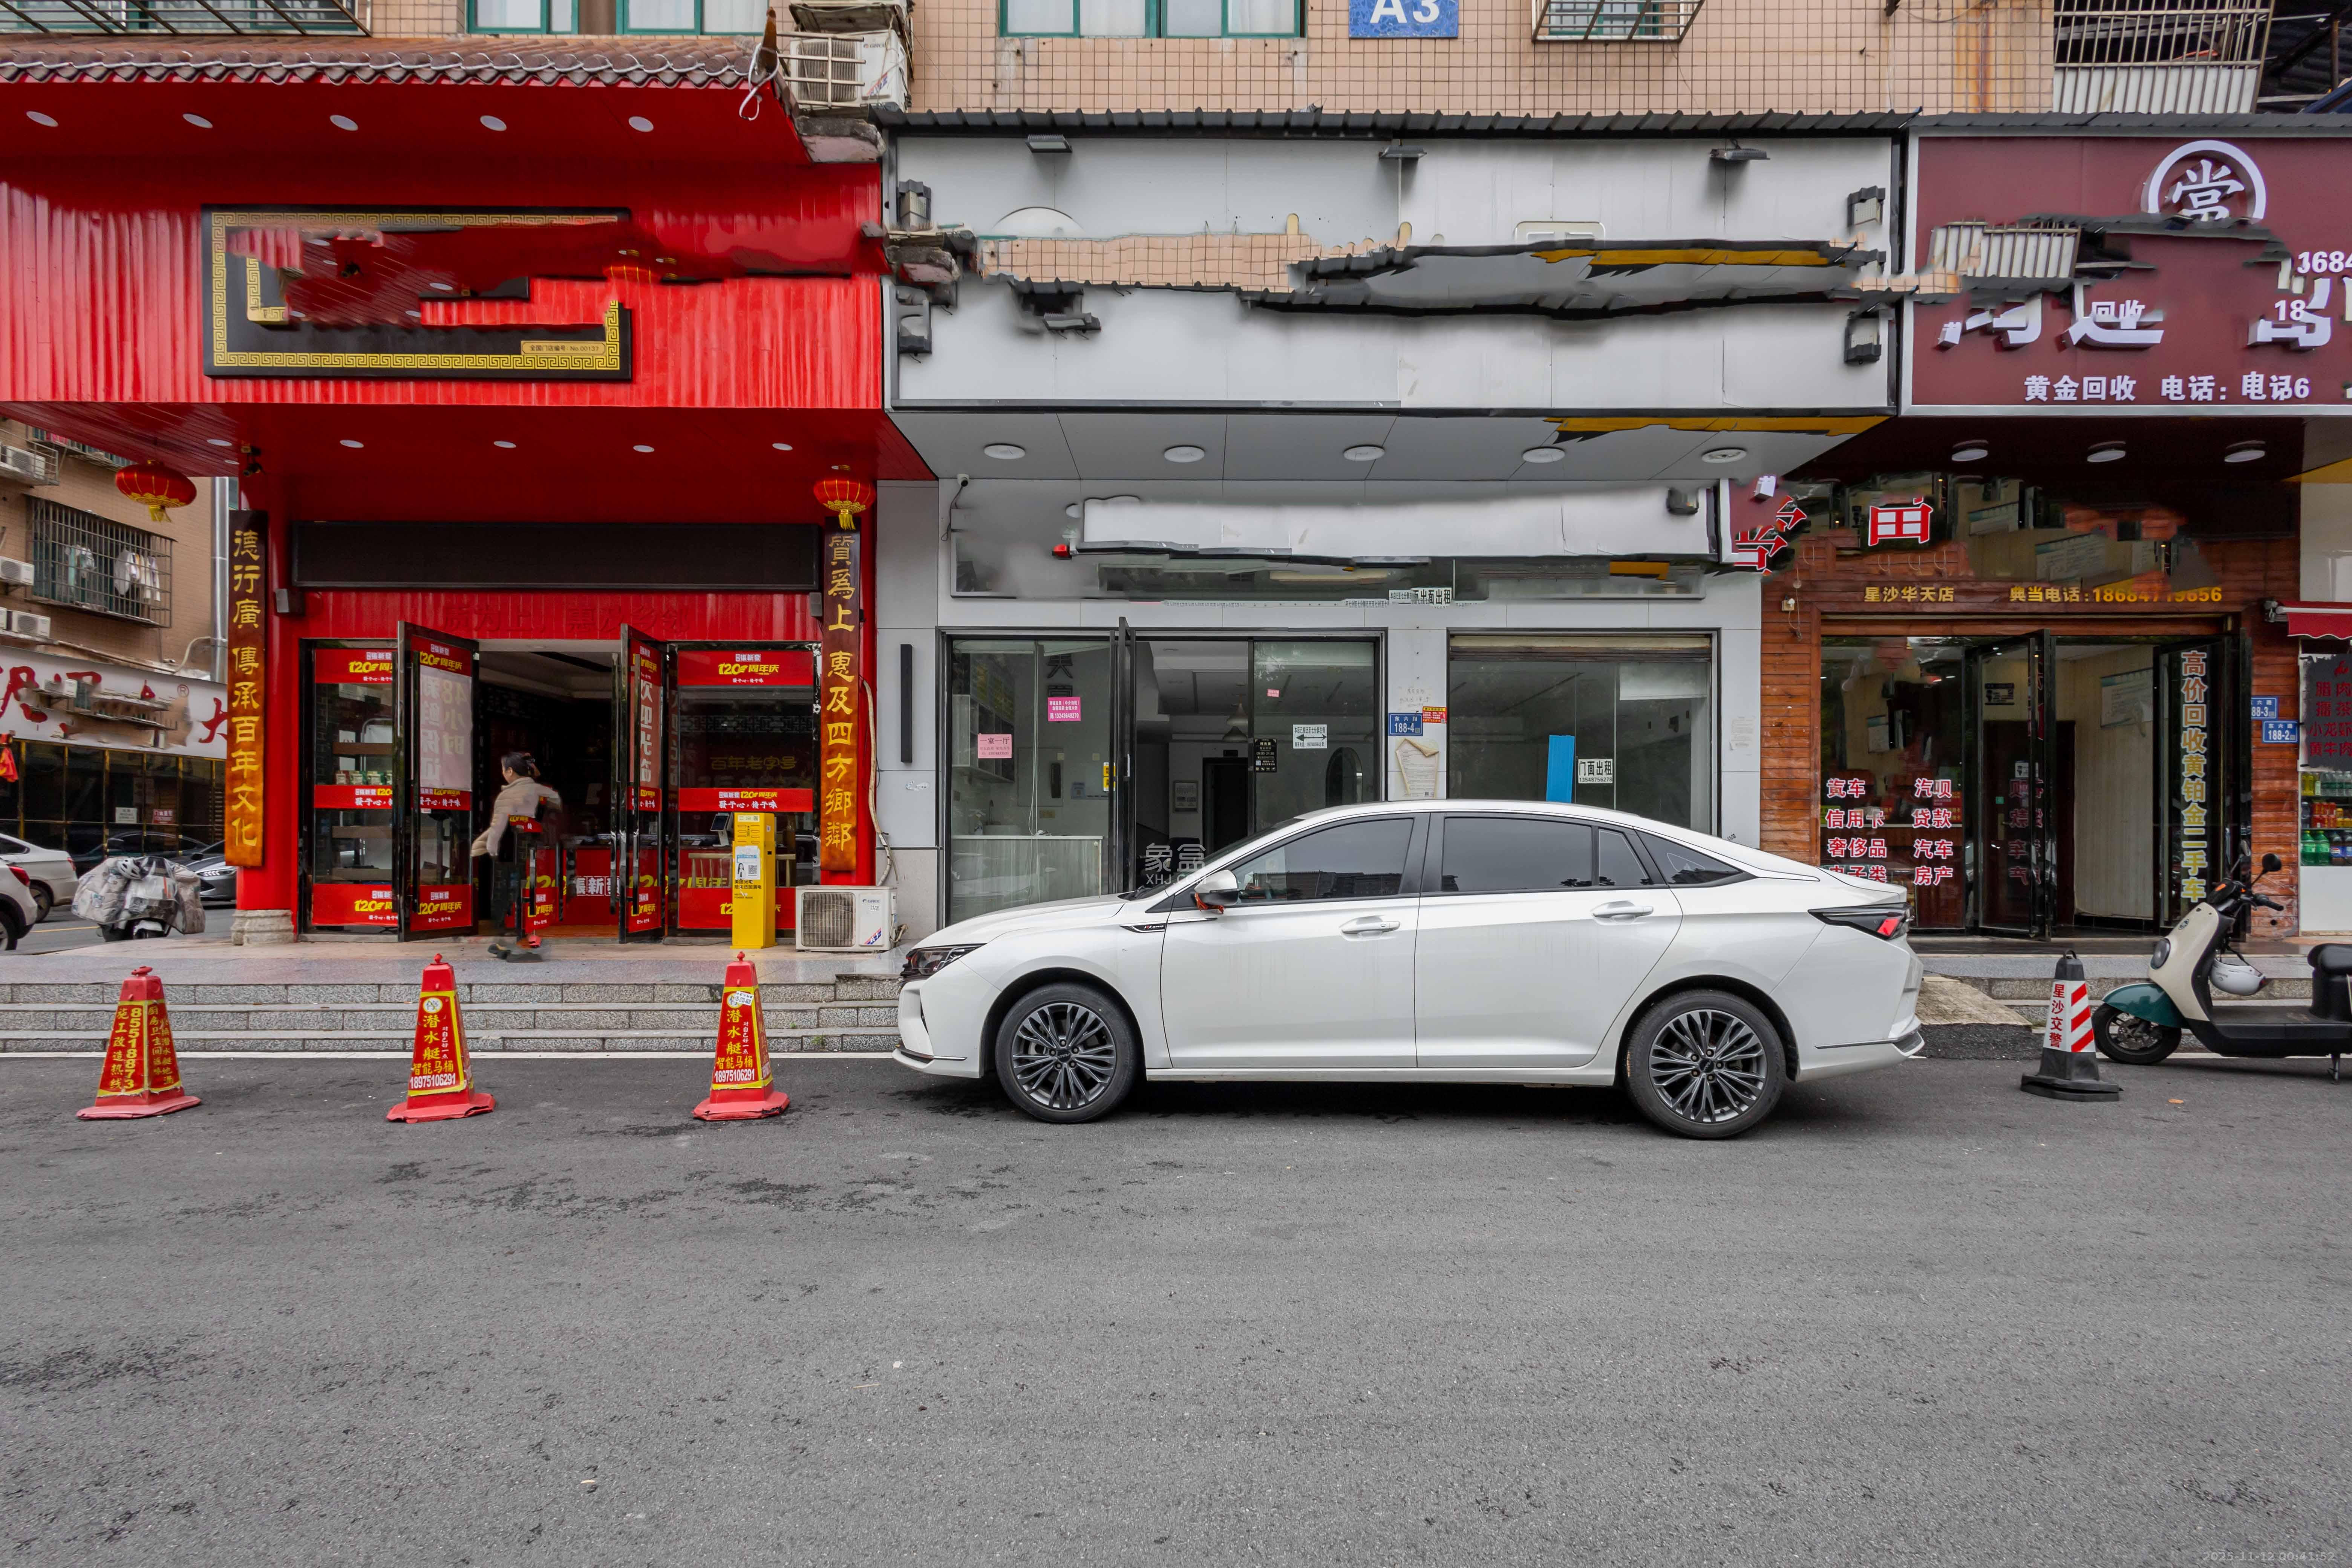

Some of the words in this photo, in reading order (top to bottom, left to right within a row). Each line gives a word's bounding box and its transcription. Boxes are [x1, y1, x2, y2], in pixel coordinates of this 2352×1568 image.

[2024, 375, 2136, 401] 黄金回收
[1864, 586, 1954, 602] 星沙华天店
[2251, 707, 2268, 717] 88-3
[1395, 723, 1414, 733] 188-4
[2268, 730, 2289, 740] 188-2
[1579, 761, 1612, 776] 门面出租
[1825, 809, 1885, 828] 信用卡
[1911, 808, 1952, 828] 贷款
[1827, 837, 1887, 858] 奢侈品
[1913, 839, 1954, 859] 汽车
[1913, 866, 1954, 886] 房产
[2049, 984, 2066, 1048] 星沙交警
[423, 1014, 440, 1060] 潜水艇
[726, 1010, 742, 1055] 潜水艇
[110, 1008, 129, 1089] 施工改造热线
[123, 1008, 142, 1089] 85518873
[413, 1060, 454, 1075] 智能马桶
[716, 1056, 753, 1069] 智能马桶
[410, 1072, 456, 1089] 18975106291
[715, 1068, 755, 1083] 18975106291
